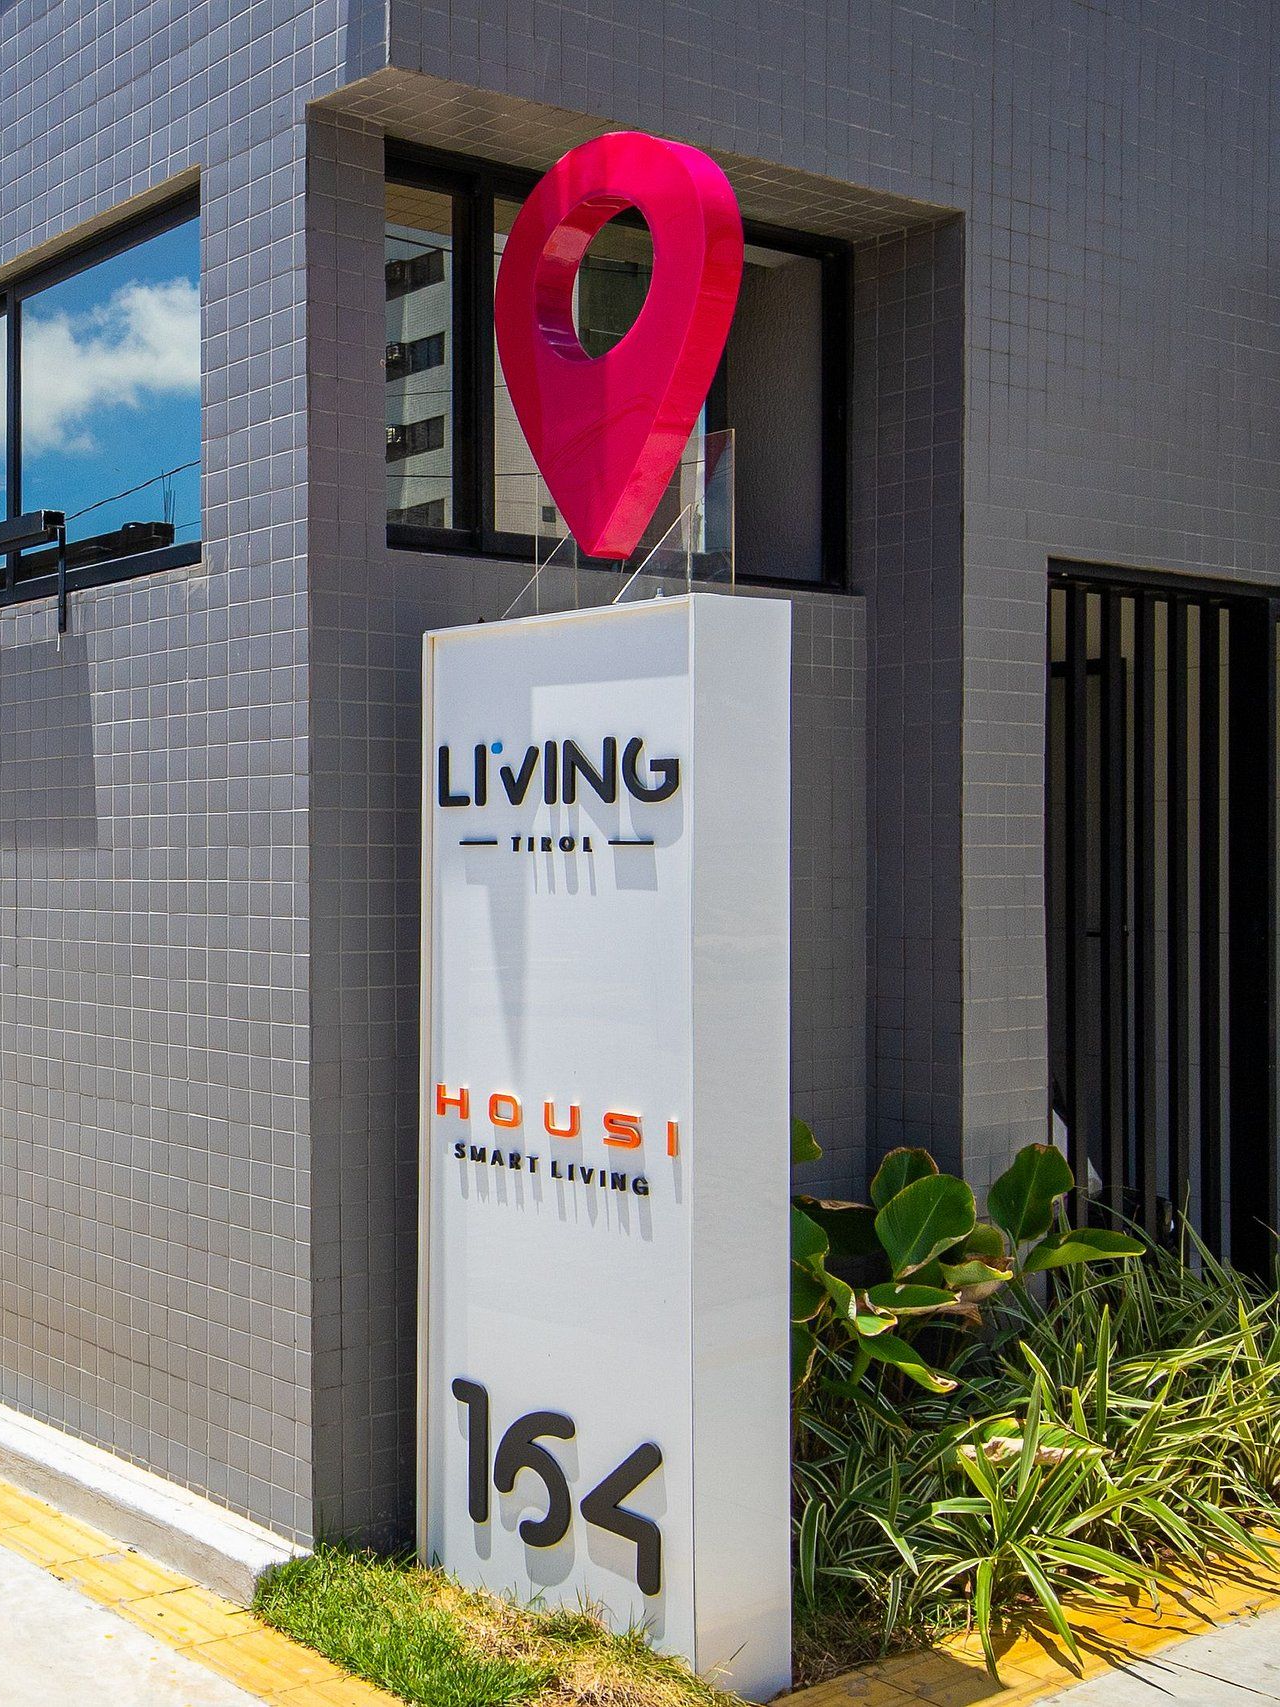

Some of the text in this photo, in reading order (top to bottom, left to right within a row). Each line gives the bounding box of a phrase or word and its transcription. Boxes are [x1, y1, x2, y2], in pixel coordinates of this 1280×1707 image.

[438, 736, 680, 808] LIVING
[510, 836, 594, 853] TIROL
[435, 1083, 678, 1158] HOUSI
[454, 1142, 651, 1197] SMART LIVING
[451, 1377, 664, 1598] 164
